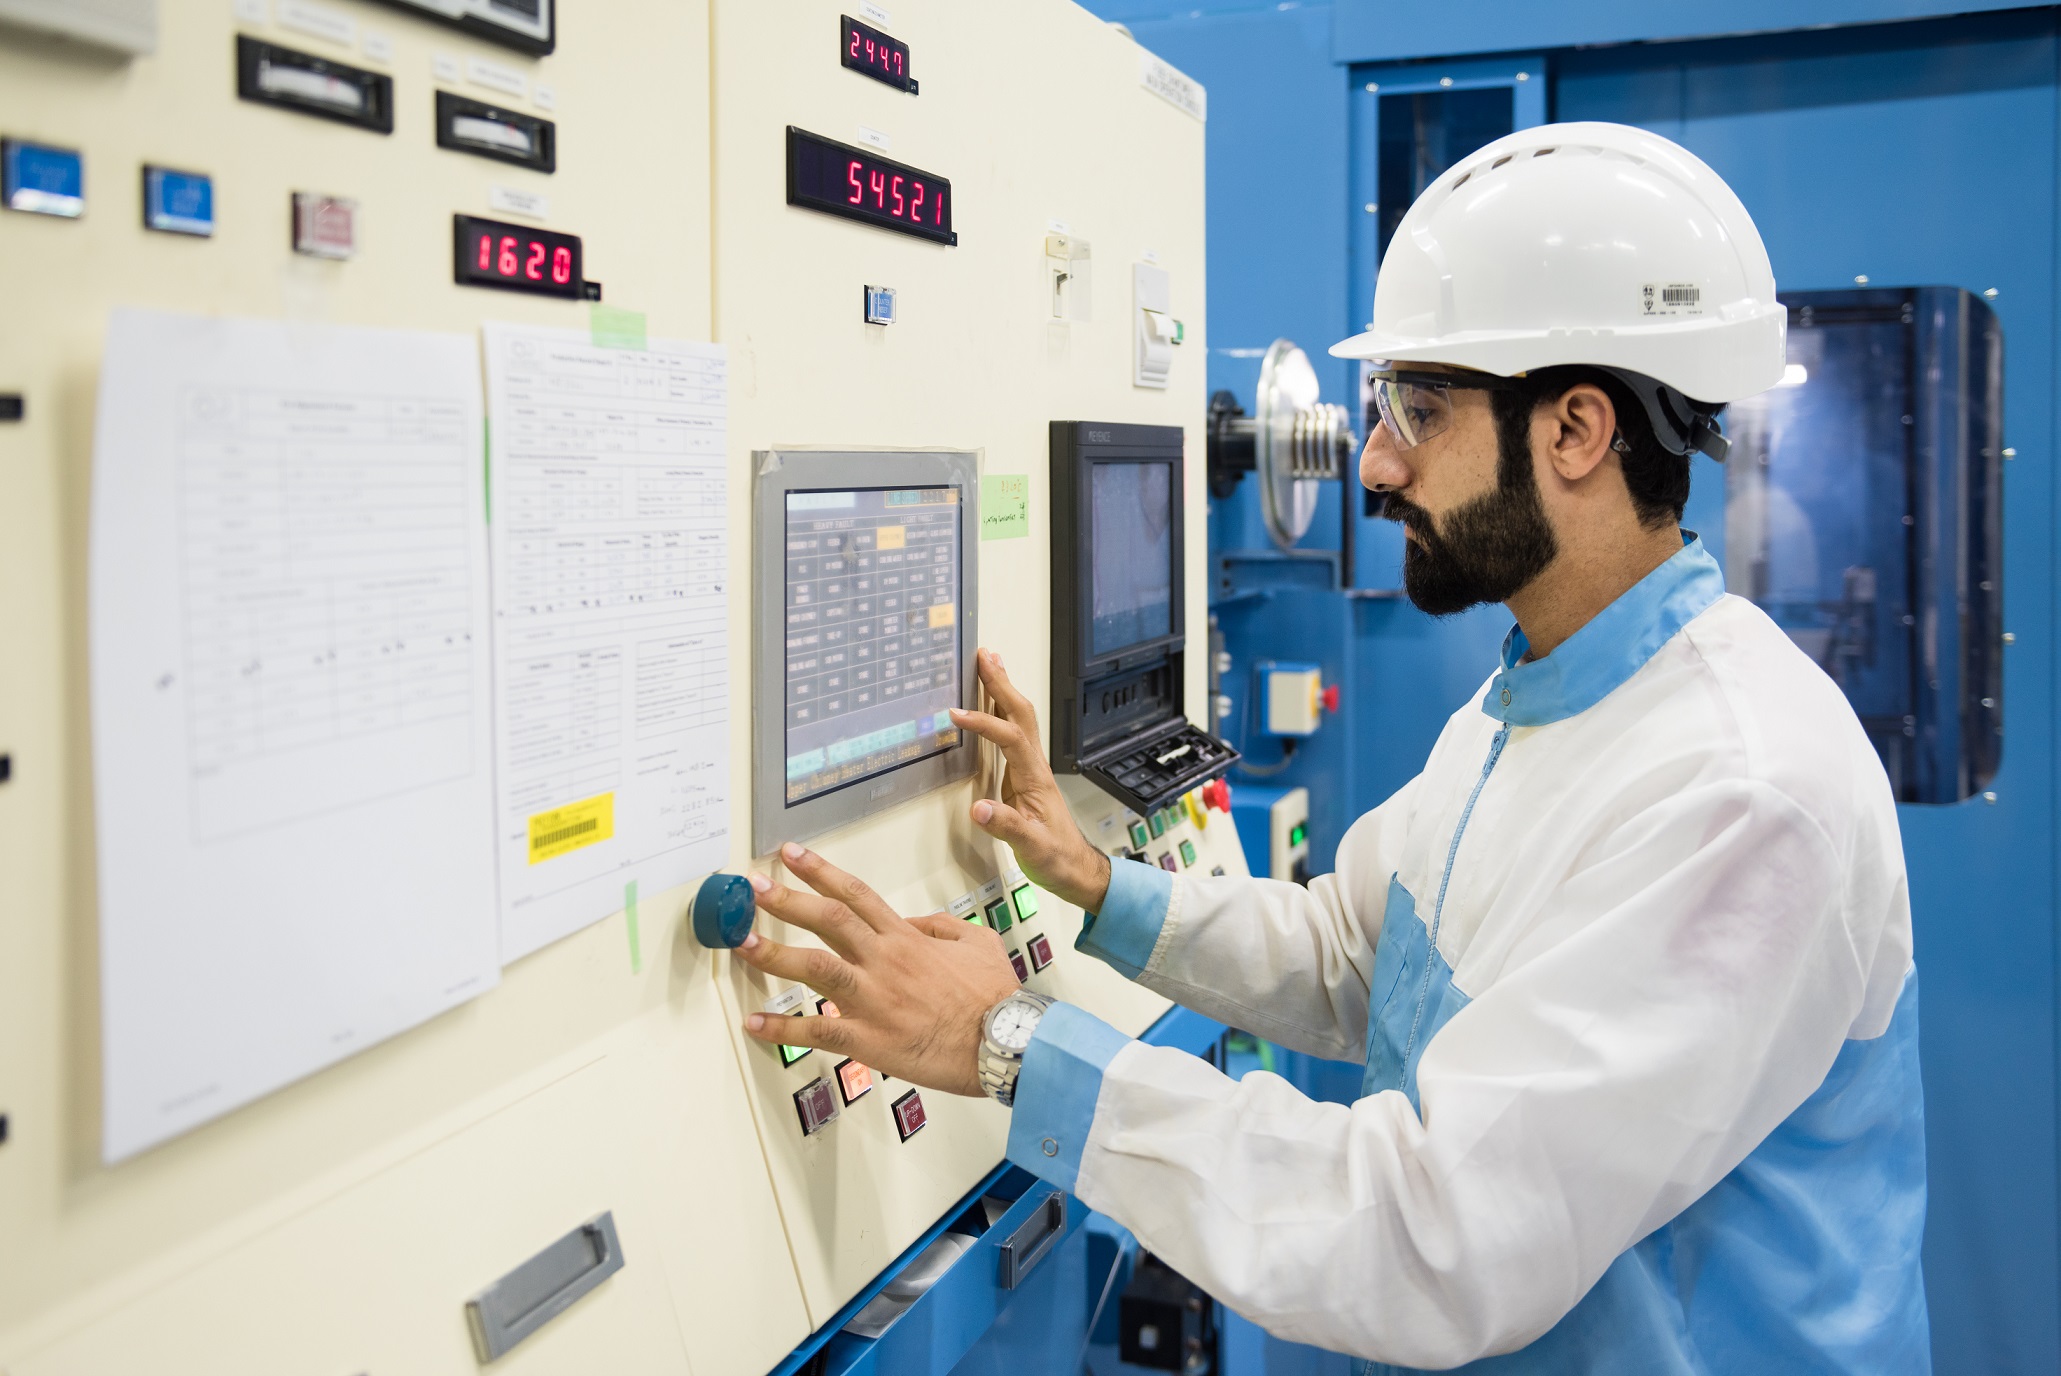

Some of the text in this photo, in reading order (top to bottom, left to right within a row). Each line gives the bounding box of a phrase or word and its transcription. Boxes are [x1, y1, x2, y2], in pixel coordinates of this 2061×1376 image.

[848, 161, 942, 225] 54521
[479, 235, 571, 284] 1620
[813, 520, 854, 530] HEAVY FAULT
[900, 515, 917, 523] LIGHT
[867, 751, 895, 770] Electric
[898, 744, 921, 760] Leakage
[815, 1099, 825, 1111] OFF
[911, 1114, 919, 1123] OFF
